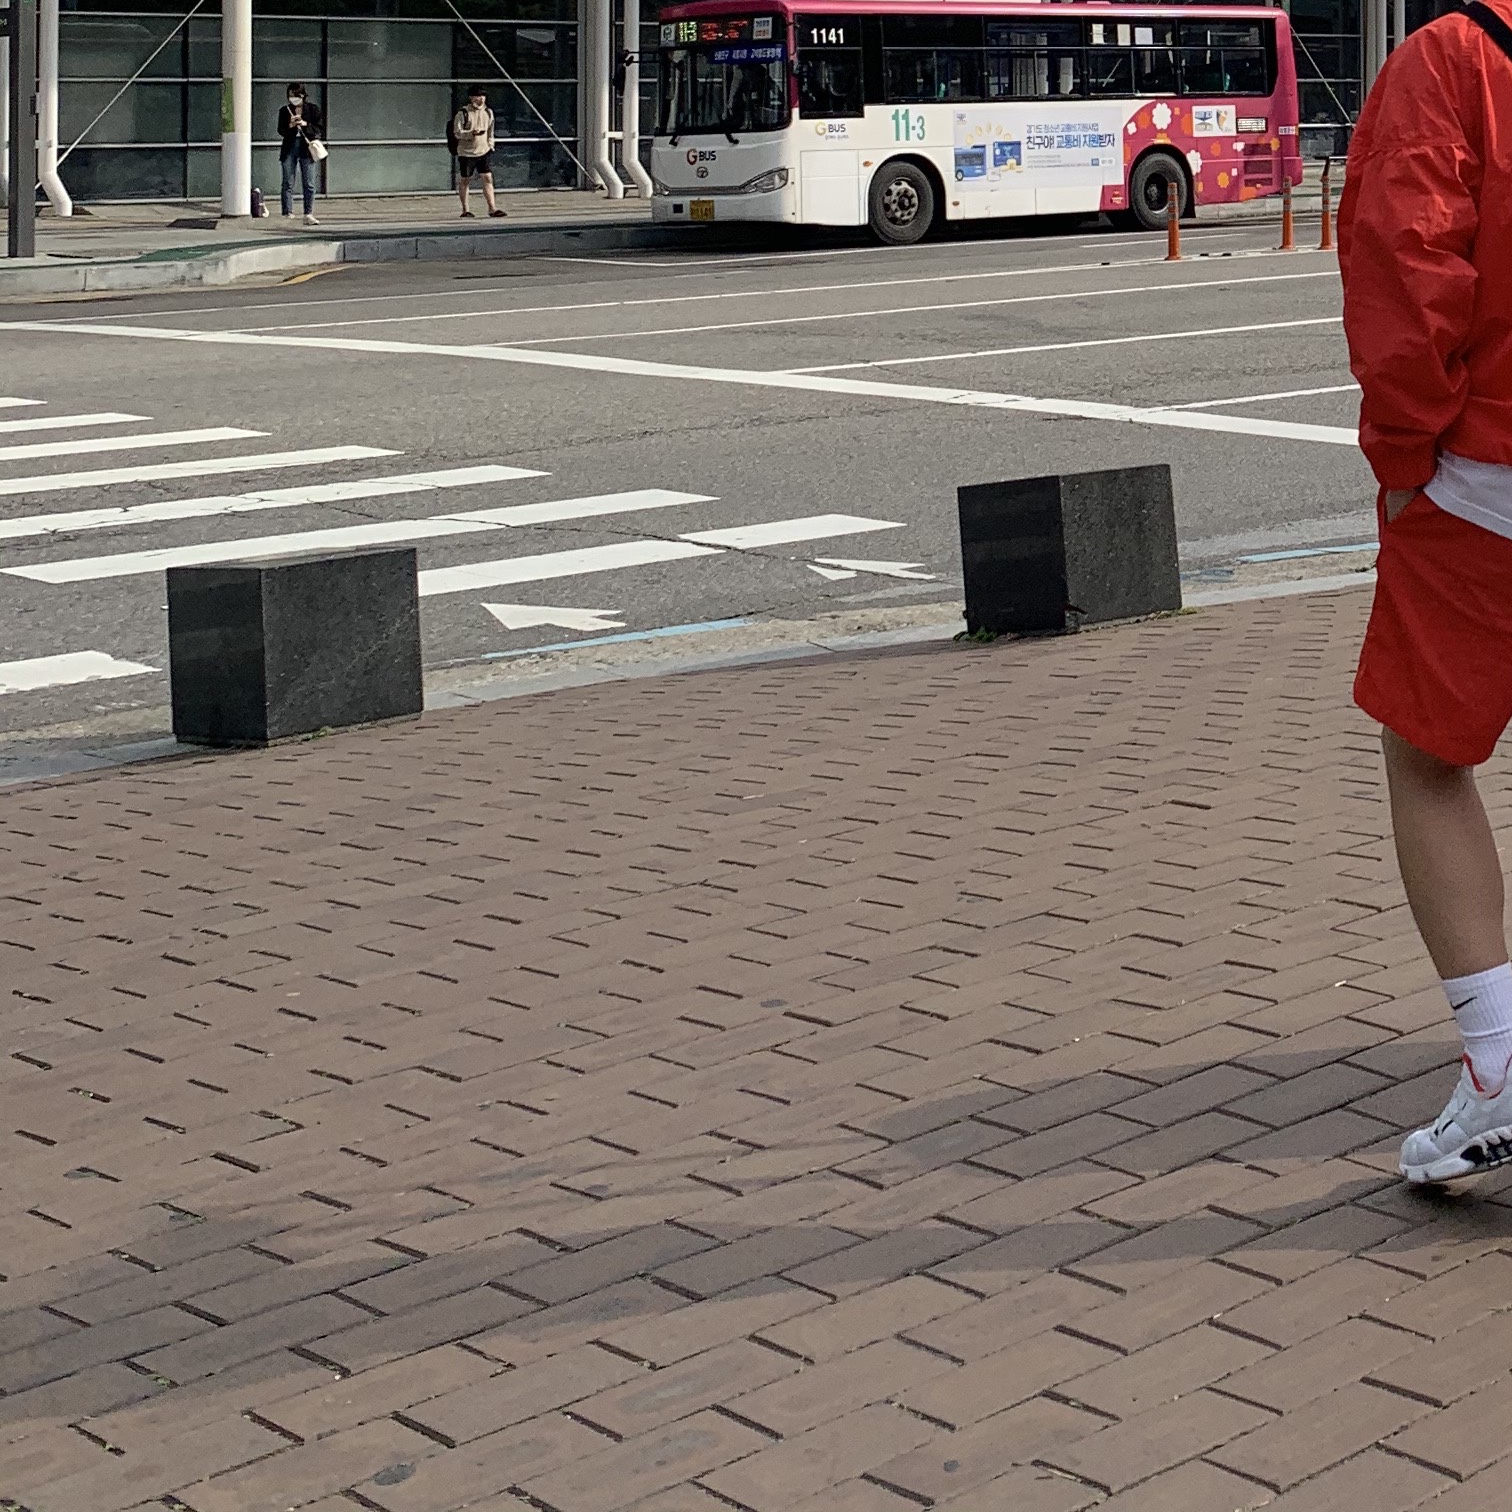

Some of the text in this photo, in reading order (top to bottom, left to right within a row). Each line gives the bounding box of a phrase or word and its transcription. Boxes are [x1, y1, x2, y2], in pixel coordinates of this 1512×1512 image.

[810, 28, 845, 44] 1141
[828, 123, 846, 133] BUS
[1056, 133, 1081, 149] 교통비
[1082, 132, 1115, 148] 지원받자
[699, 150, 717, 162] BUS
